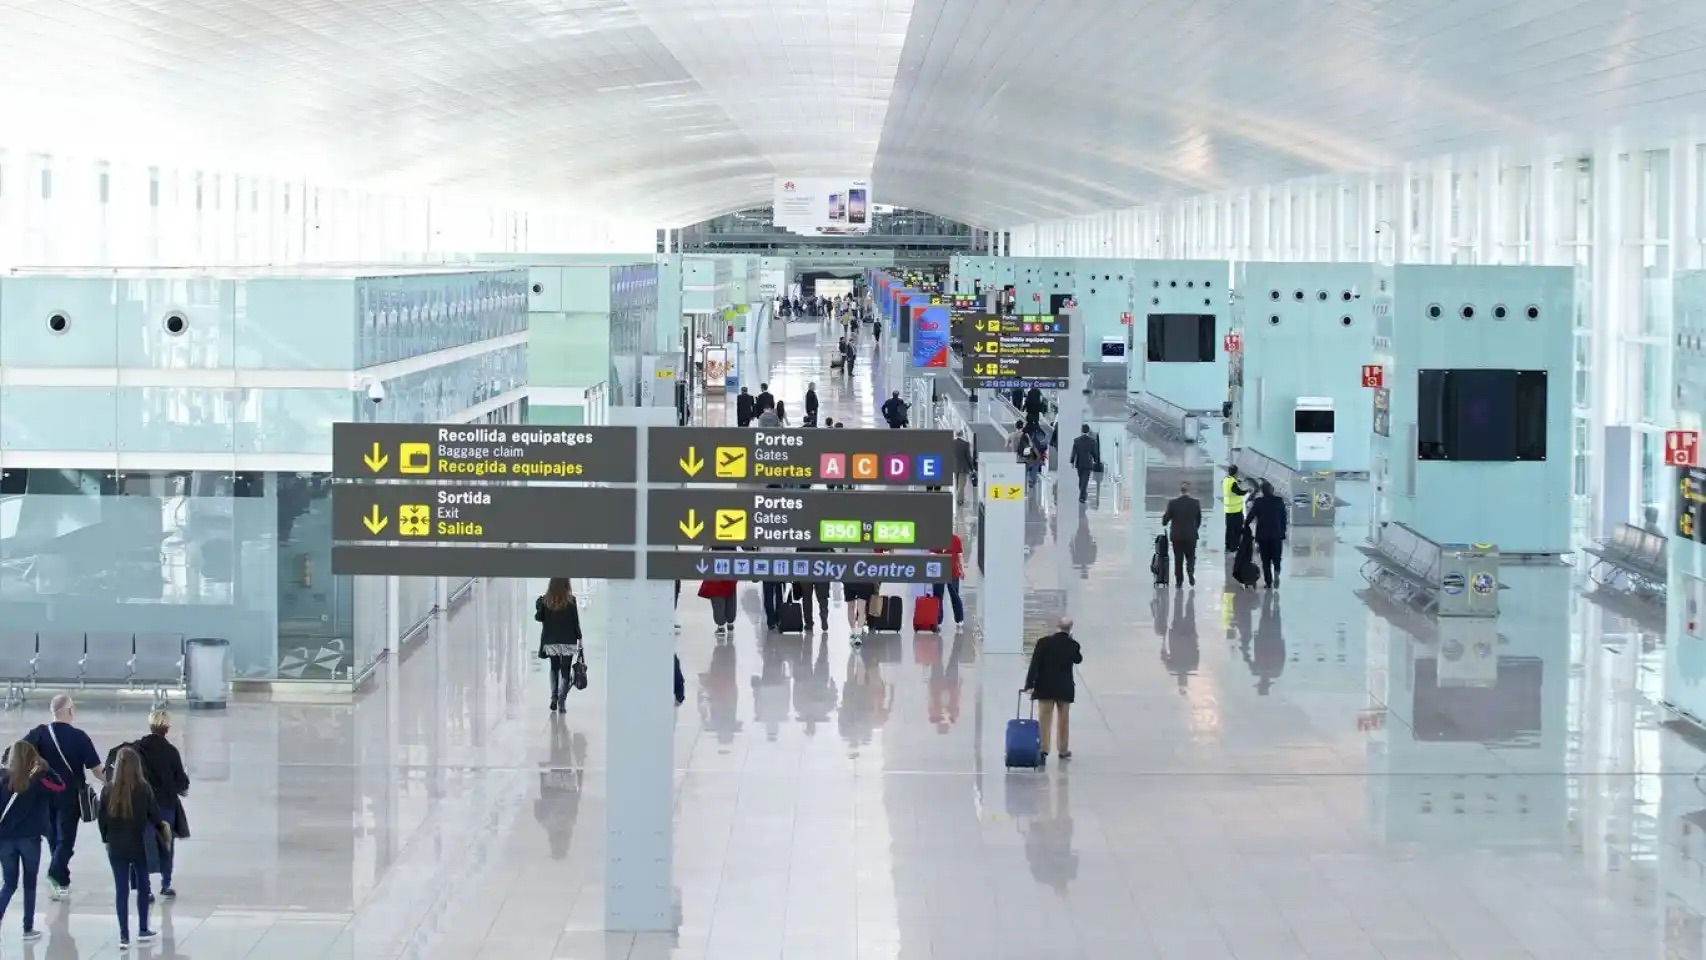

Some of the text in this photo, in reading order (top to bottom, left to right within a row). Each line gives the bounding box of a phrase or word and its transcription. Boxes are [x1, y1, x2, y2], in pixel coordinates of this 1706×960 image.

[438, 428, 593, 445] Recollida equipatges
[755, 432, 803, 446] Portes
[438, 445, 524, 459] Baggage claim
[755, 449, 788, 461] Gates
[438, 460, 583, 476] Recogida equipajes
[755, 464, 812, 477] Puertas
[826, 460, 935, 475] A C D E
[437, 491, 491, 504] Sortida
[754, 496, 803, 509] Portes
[437, 507, 459, 519] Exit
[754, 512, 787, 524] Gates
[437, 522, 483, 536] Salida
[754, 527, 811, 541] Puertas
[825, 523, 910, 538] B50 to B24
[812, 561, 915, 580] Sky Centre
